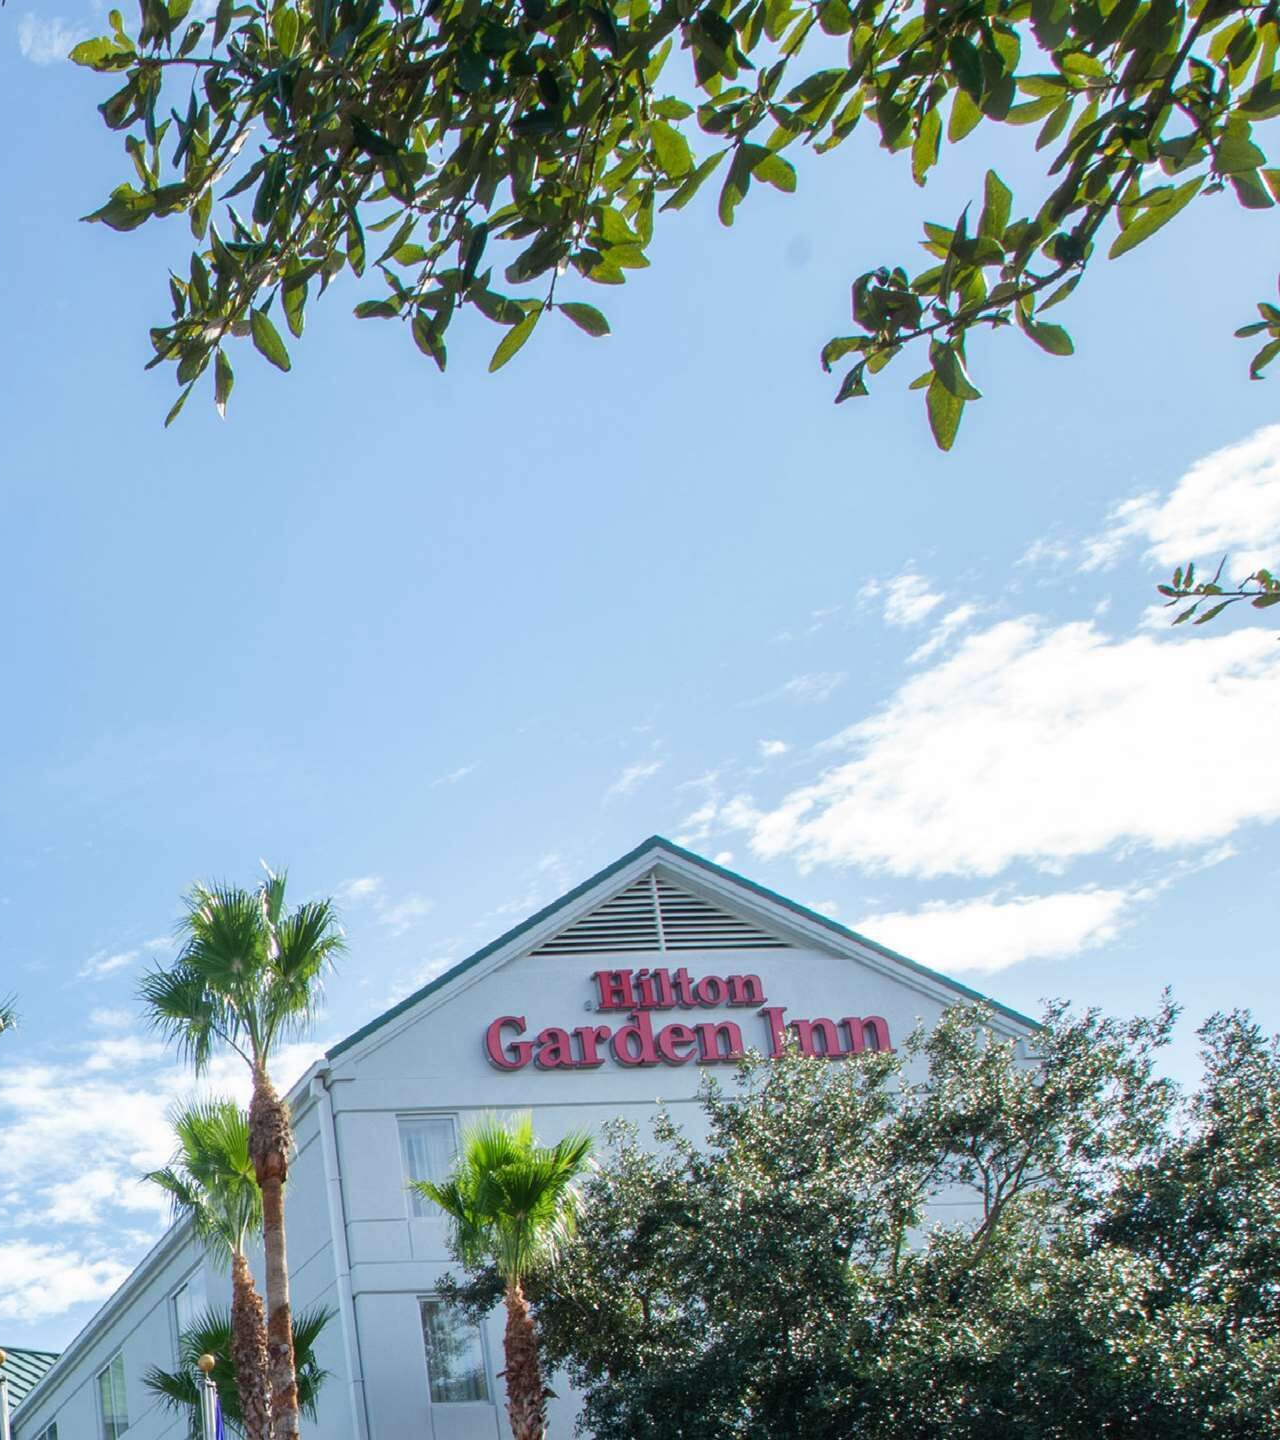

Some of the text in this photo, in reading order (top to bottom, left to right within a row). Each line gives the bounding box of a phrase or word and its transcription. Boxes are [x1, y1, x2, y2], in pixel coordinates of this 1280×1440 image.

[593, 967, 768, 1013] Hilton
[484, 1006, 898, 1071] Garden Inn
